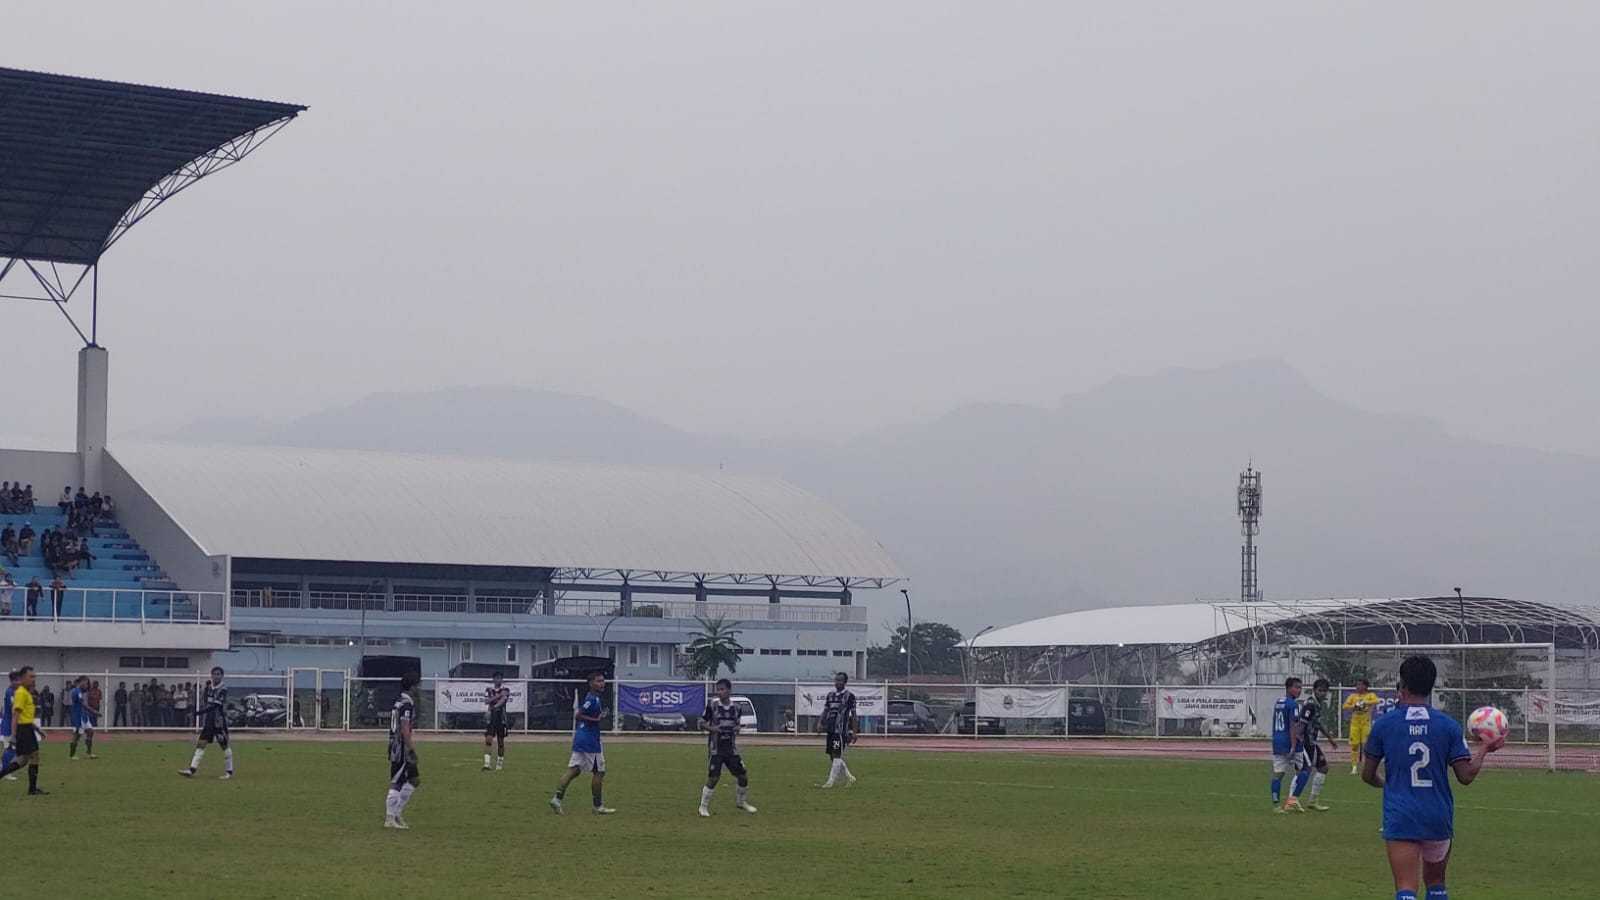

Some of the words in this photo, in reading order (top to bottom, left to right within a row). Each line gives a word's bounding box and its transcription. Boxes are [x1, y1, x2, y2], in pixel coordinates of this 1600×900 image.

[652, 691, 683, 704] PSSI
[1409, 725, 1428, 736] RAFI
[1408, 741, 1433, 788] 2
